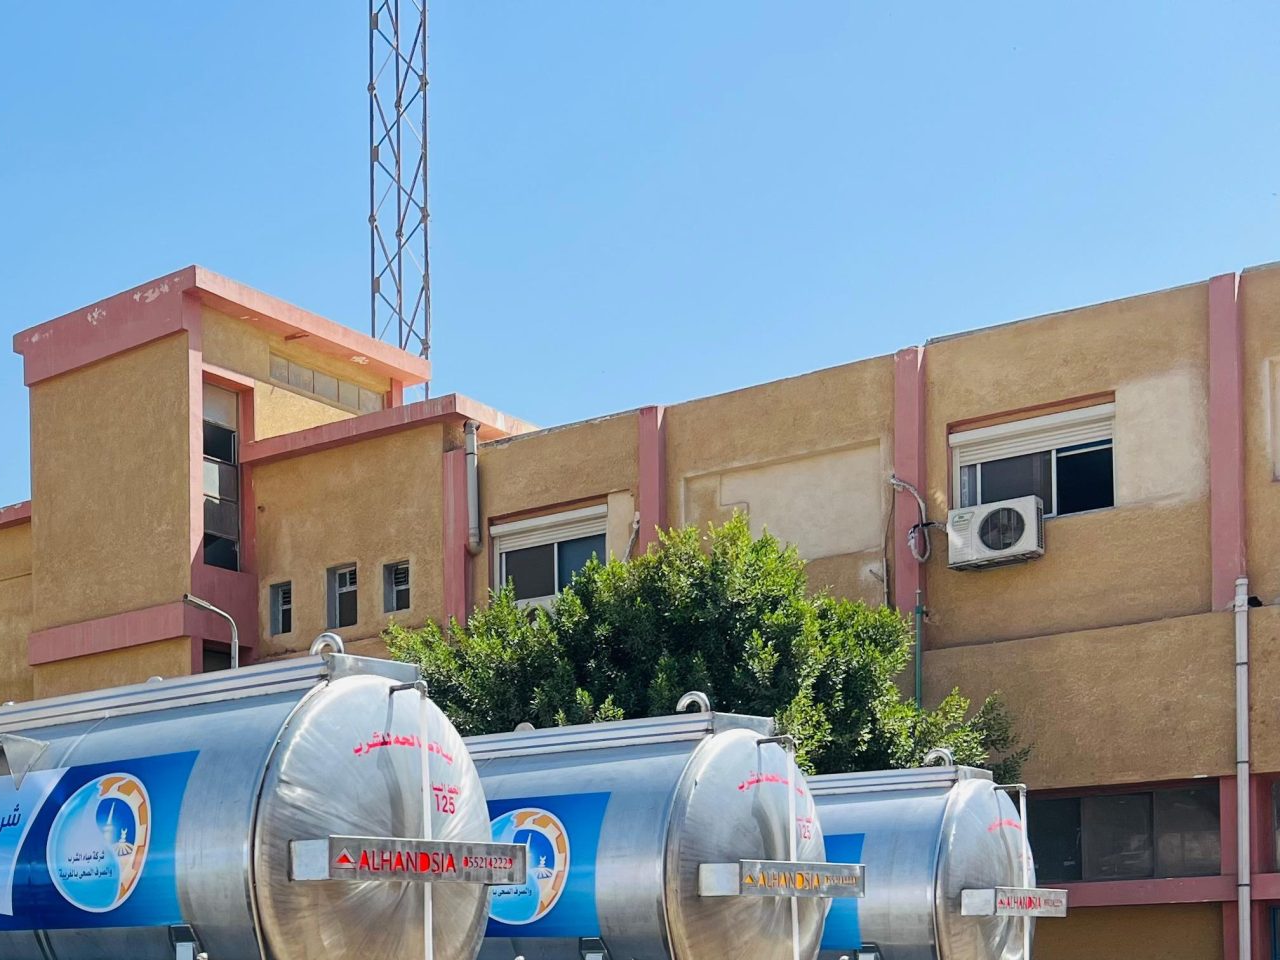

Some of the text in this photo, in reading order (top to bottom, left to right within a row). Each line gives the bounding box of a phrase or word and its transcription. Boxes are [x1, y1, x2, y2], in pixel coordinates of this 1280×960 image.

[434, 794, 456, 815] 125
[359, 850, 456, 874] ALHANDSIA
[758, 871, 820, 890] ALHANDSIA
